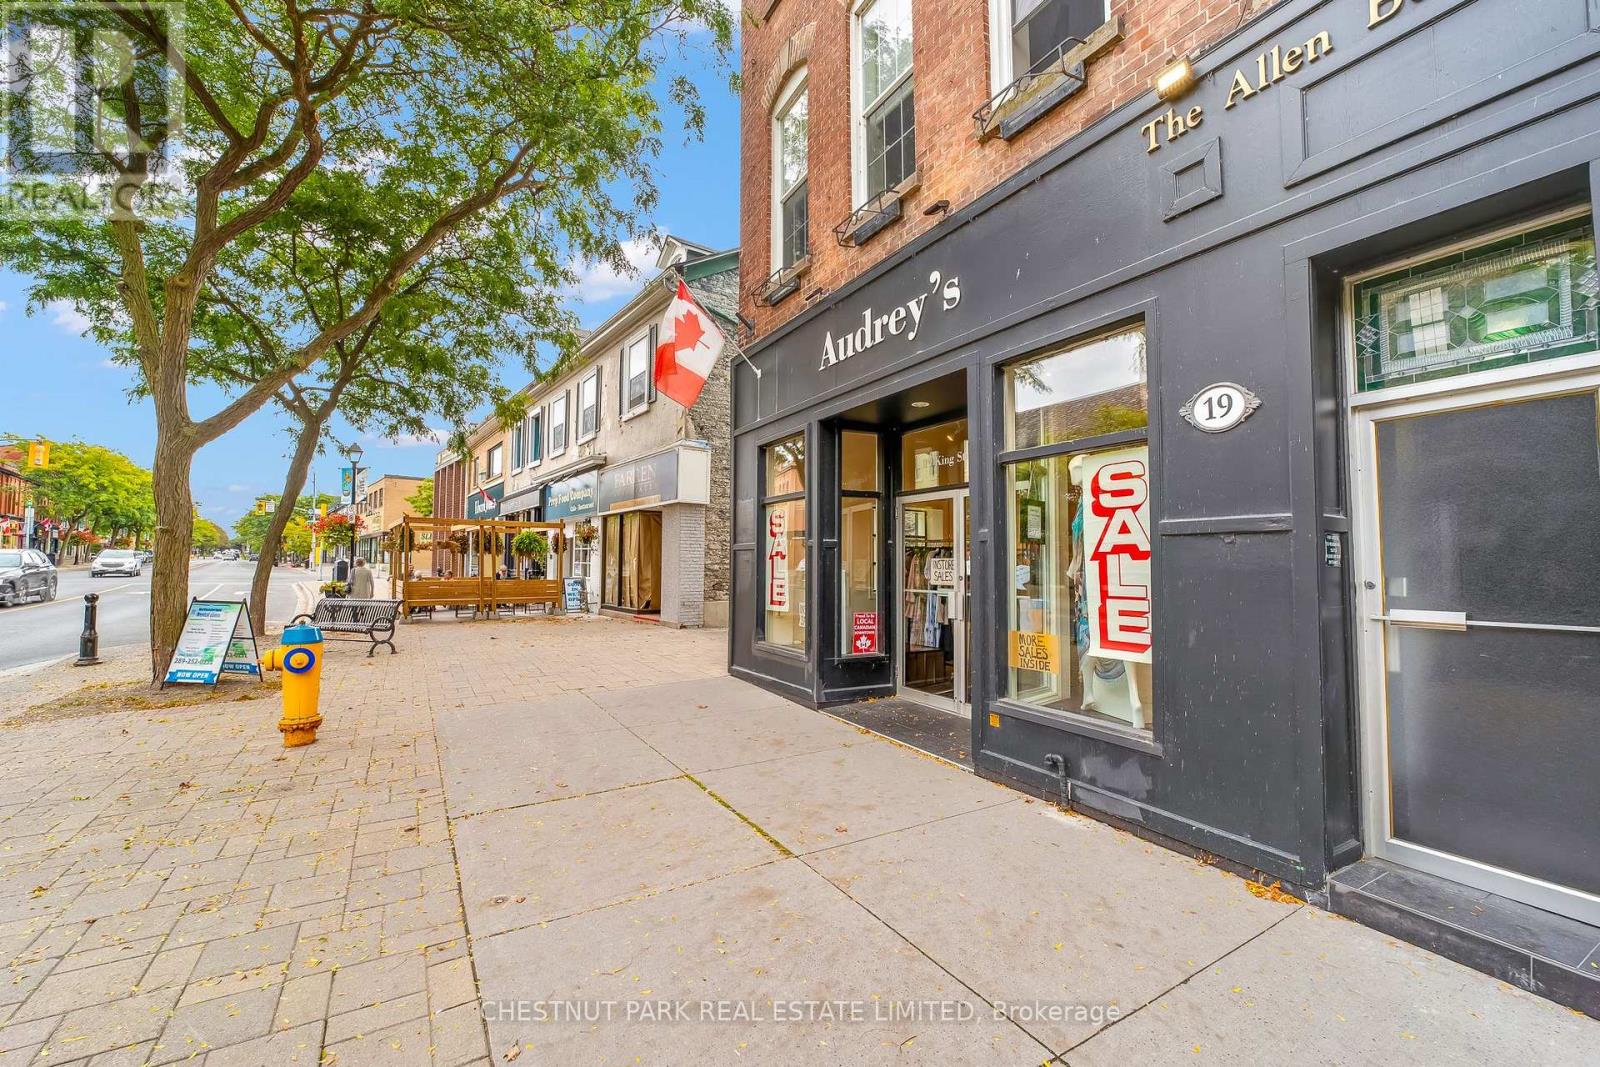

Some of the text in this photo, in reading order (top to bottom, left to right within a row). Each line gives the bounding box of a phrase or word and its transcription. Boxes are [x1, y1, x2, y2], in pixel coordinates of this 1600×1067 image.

[1141, 106, 1202, 152] The
[1225, 31, 1333, 110] Allen
[819, 270, 962, 372] Audrey's
[1203, 393, 1234, 421] 19
[935, 454, 955, 466] King
[769, 509, 787, 606] SALE
[1090, 460, 1151, 653] SALE
[933, 571, 953, 582] SALES
[1019, 634, 1046, 647] MORE
[1019, 646, 1049, 660] SALES
[1020, 659, 1051, 671] INSIDE
